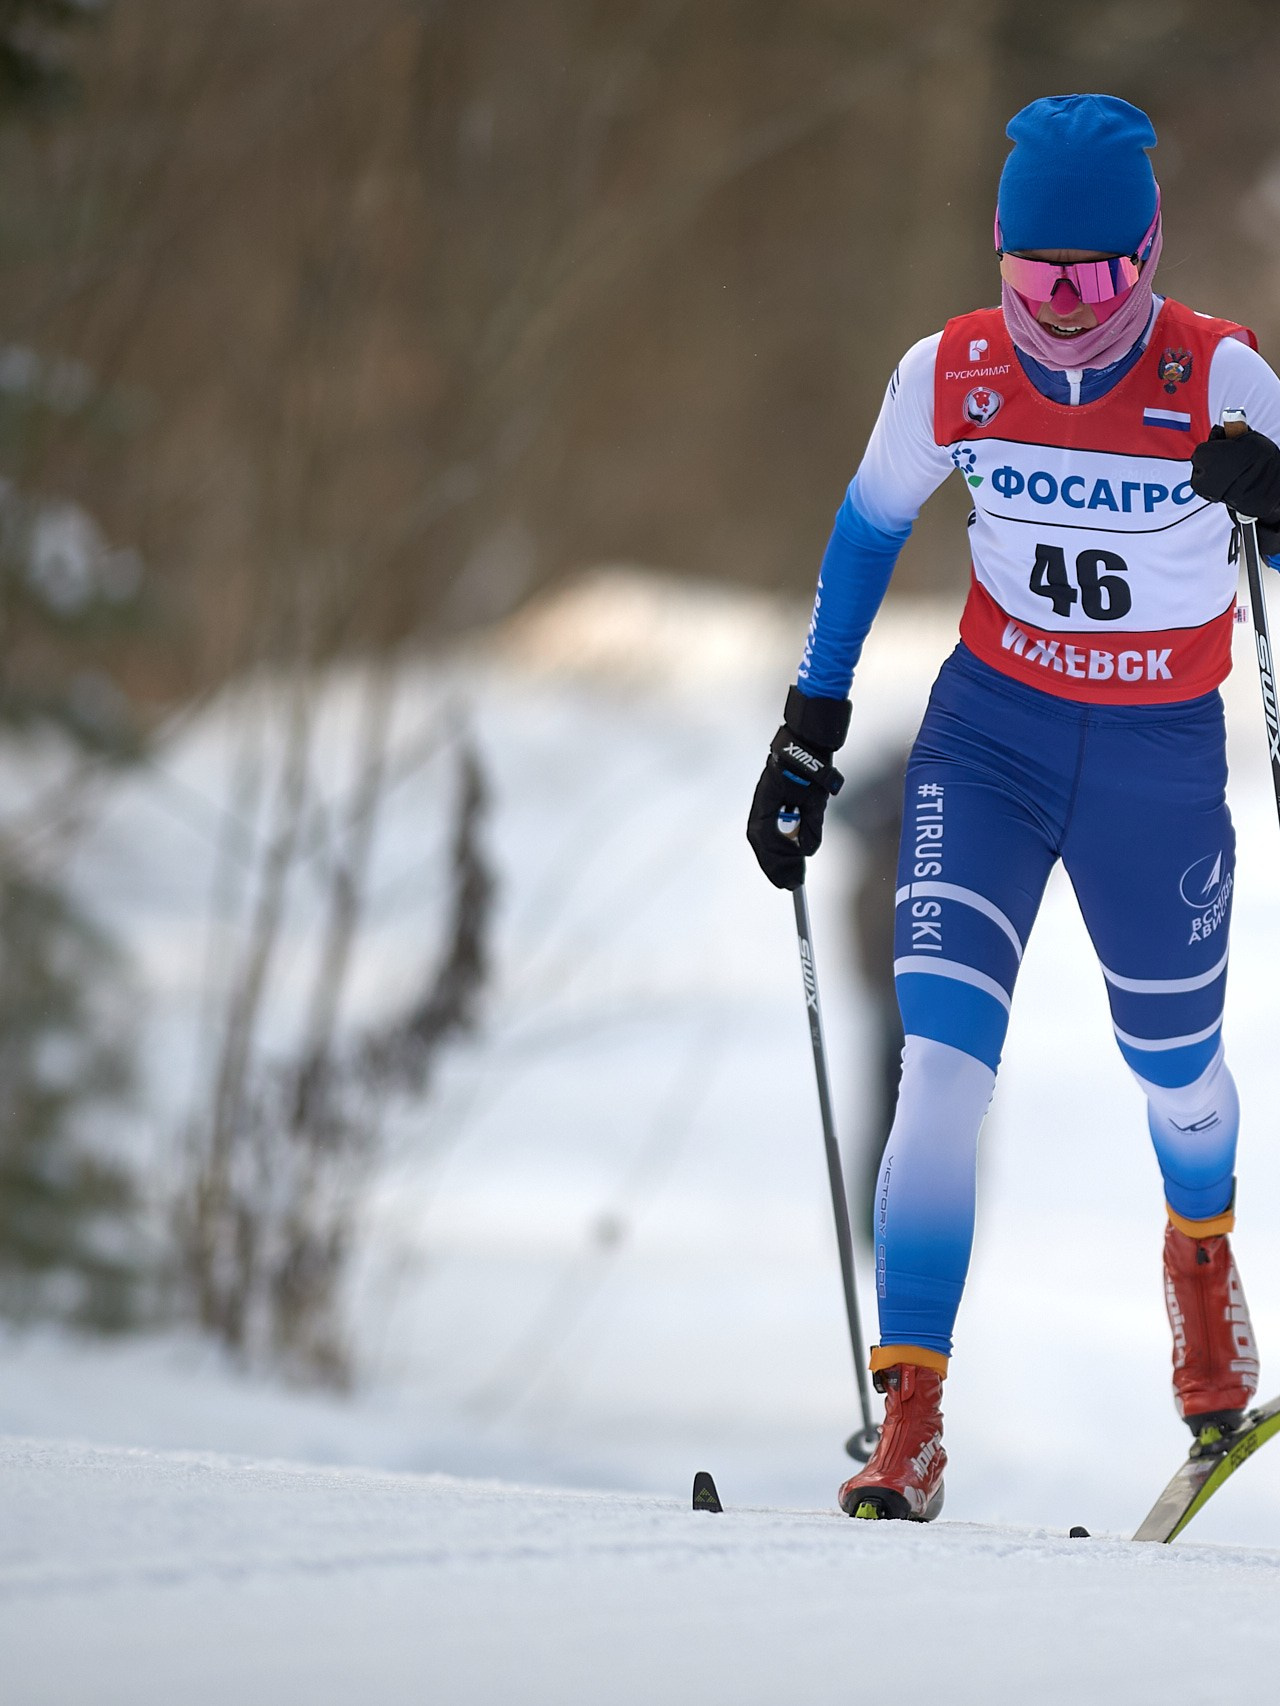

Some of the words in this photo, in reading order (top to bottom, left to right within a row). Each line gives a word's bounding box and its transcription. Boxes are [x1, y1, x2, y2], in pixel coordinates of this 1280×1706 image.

[945, 364, 1011, 380] РУСКЛИМАТ
[991, 464, 1197, 513] ФОСАГРО
[1028, 543, 1132, 621] 46
[1000, 621, 1173, 681] ИЖЕВСК
[783, 741, 825, 772] SWIX
